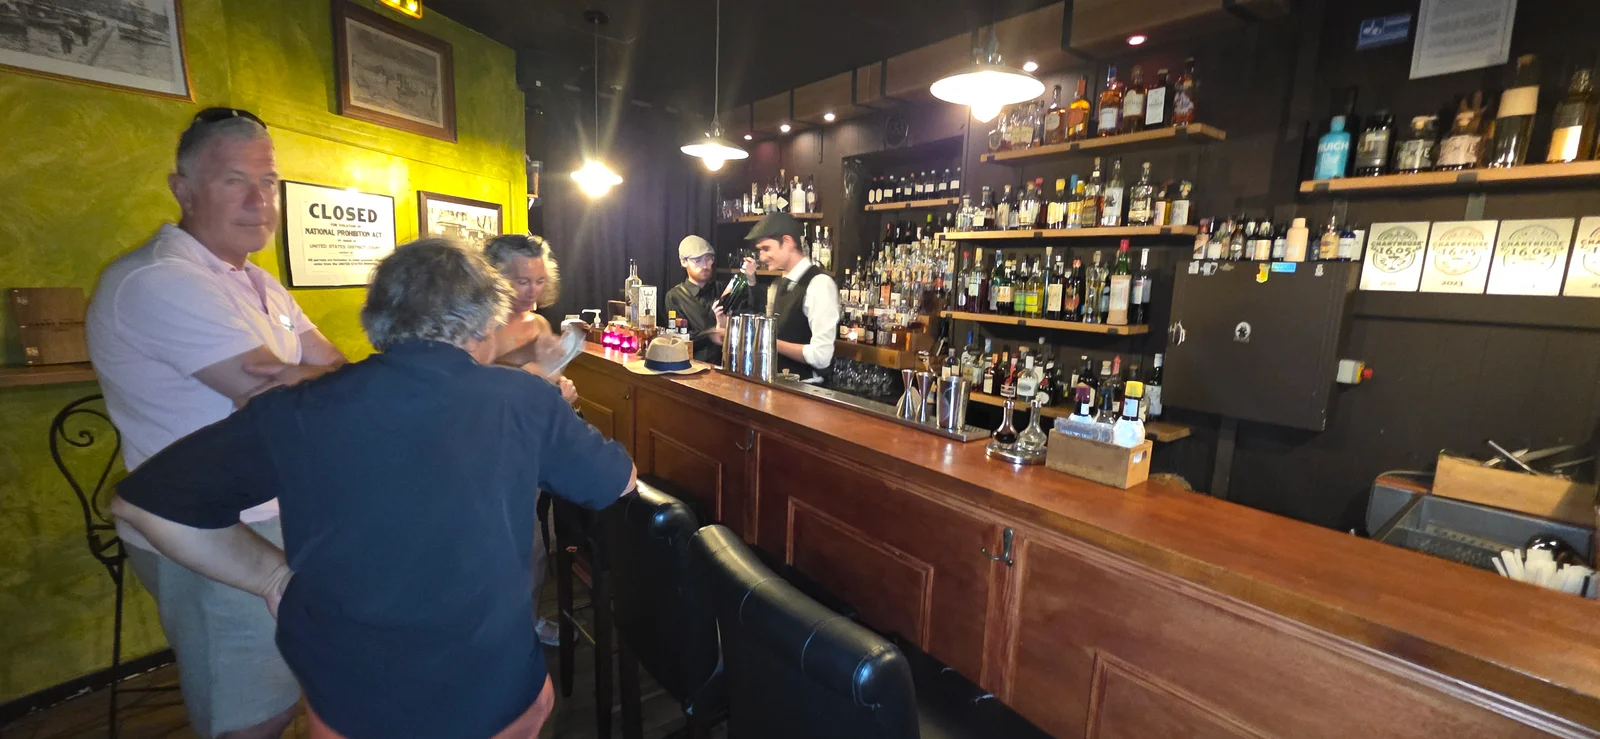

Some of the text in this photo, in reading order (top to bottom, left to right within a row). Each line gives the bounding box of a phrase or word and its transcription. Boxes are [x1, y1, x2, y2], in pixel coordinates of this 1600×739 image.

[309, 203, 377, 223] CLOSED
[305, 227, 335, 237] NATIONAL
[337, 229, 370, 238] PROHIBITION
